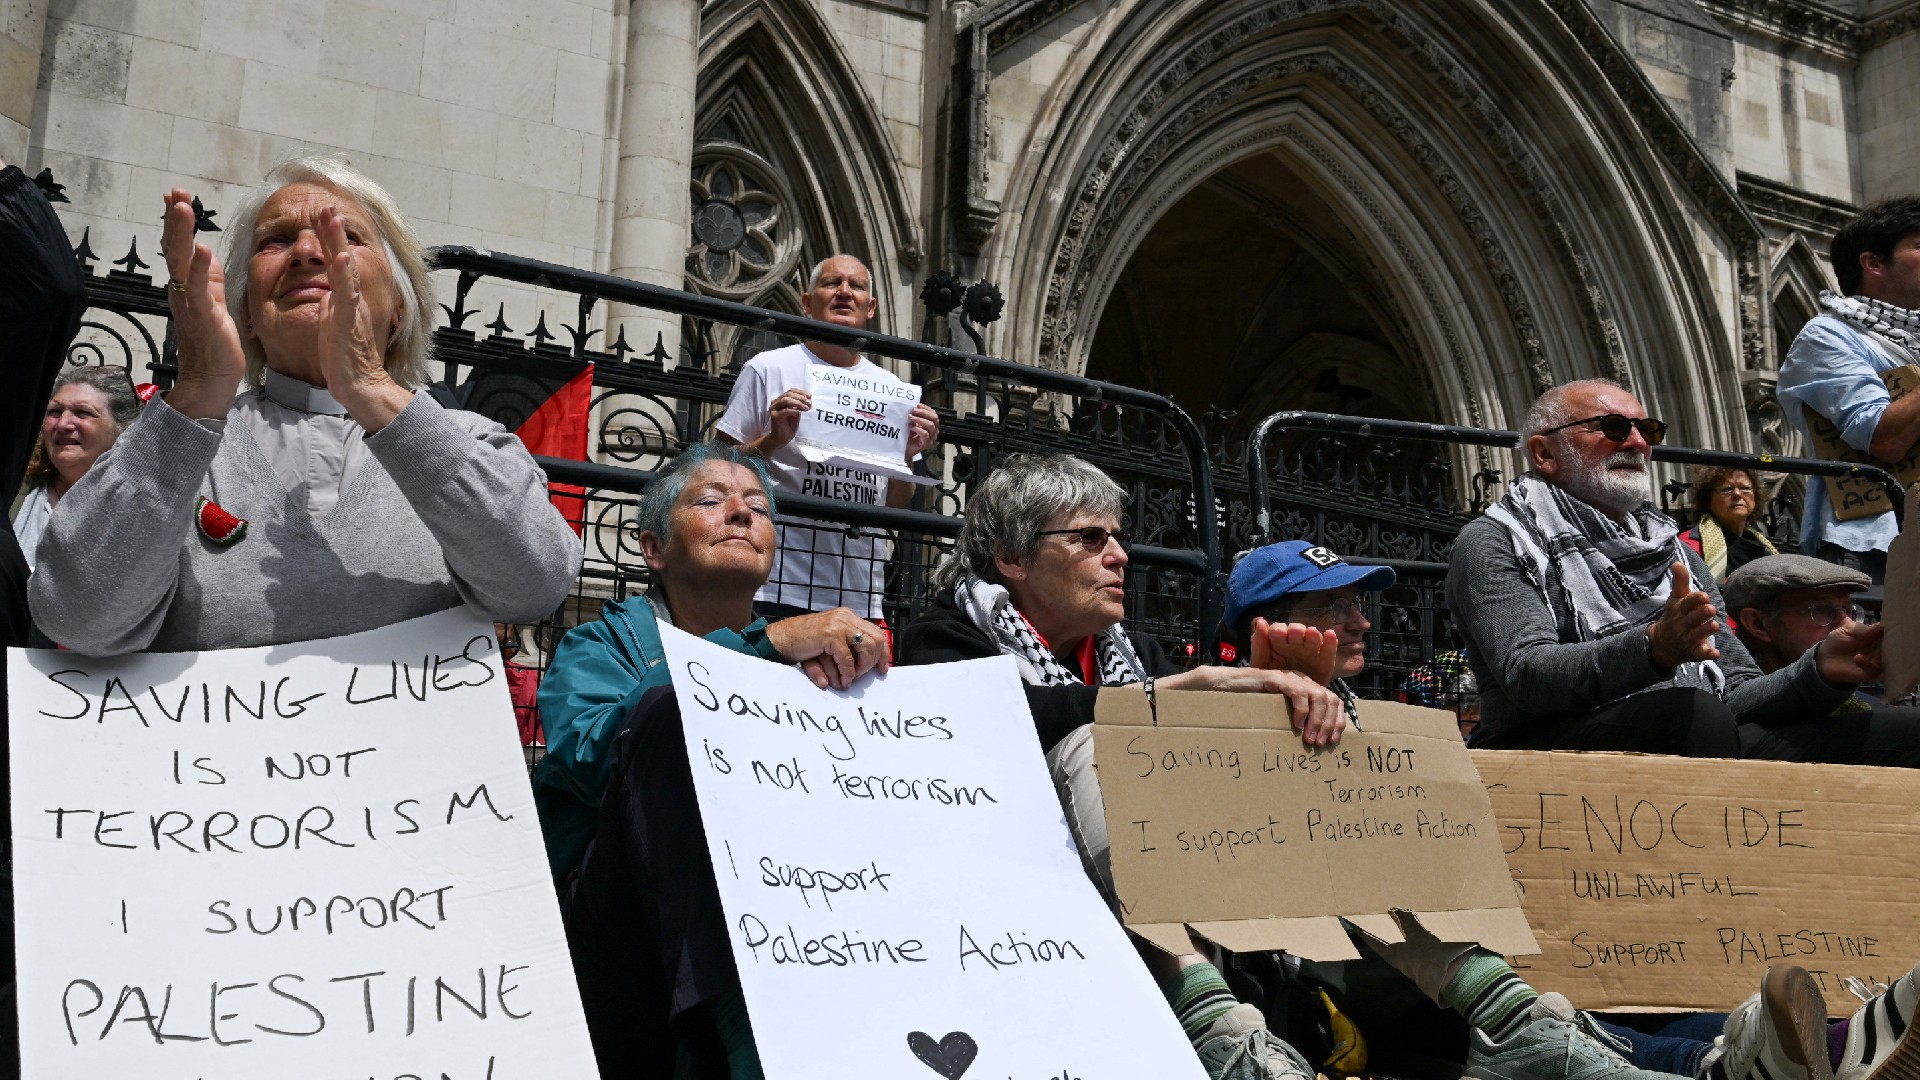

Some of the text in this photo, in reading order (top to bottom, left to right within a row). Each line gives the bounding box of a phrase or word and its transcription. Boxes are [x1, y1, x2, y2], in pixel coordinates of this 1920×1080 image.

[812, 371, 915, 400] SAVING LIVES
[837, 393, 888, 415] IS NOT
[815, 408, 901, 439] TERRORISM
[39, 635, 497, 728] SAVING LIVES
[686, 661, 953, 762] Saving lives
[173, 747, 377, 785] IS NOT
[703, 738, 998, 806] is not terrorism
[1126, 735, 1415, 779] Saving Lives is NOT
[44, 780, 514, 853] TERRORISM
[1323, 778, 1427, 803] Terrorism
[1131, 808, 1477, 864] I support Palestine Action
[724, 839, 892, 912] I support
[120, 886, 455, 935] I SUPPORT
[738, 913, 1086, 972] Palestine Action
[1716, 927, 1881, 965] PALESTINE
[62, 965, 533, 1046] PALESTINE
